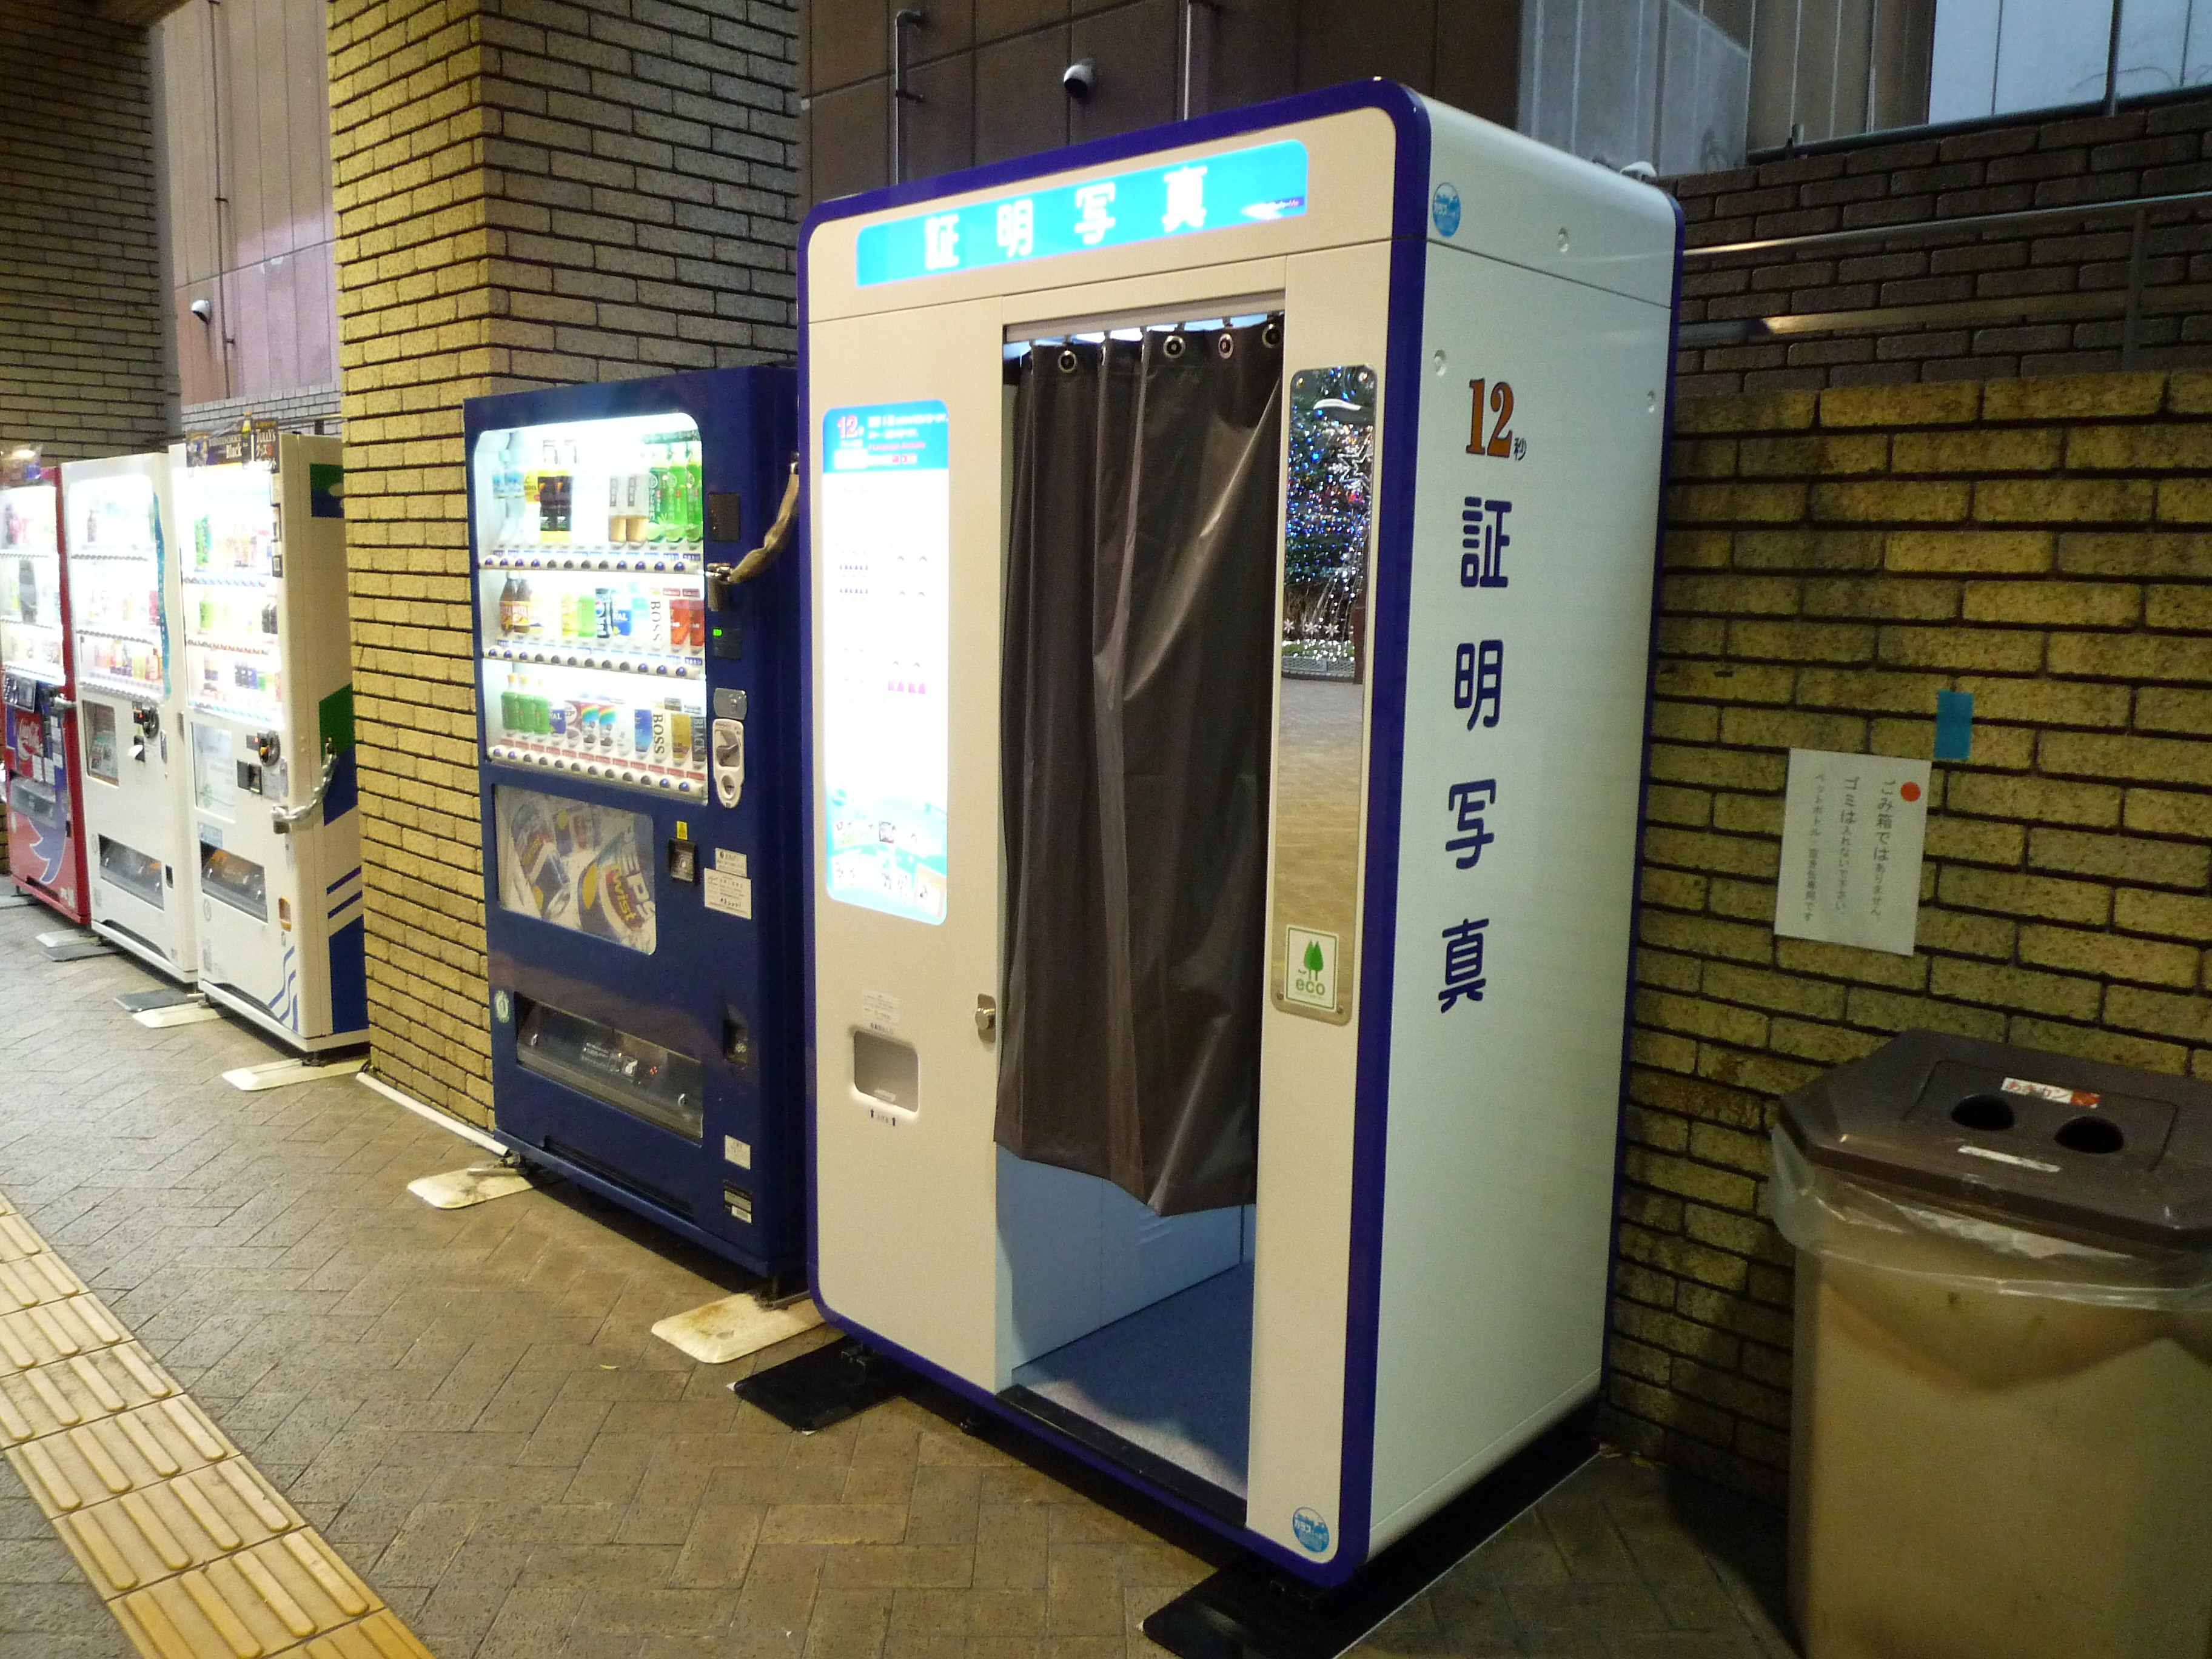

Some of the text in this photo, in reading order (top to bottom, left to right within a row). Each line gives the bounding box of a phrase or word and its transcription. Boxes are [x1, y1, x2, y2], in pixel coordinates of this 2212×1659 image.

[923, 165, 1209, 271] 証明写真
[1466, 378, 1527, 461] 12秒
[651, 601, 663, 642] BOSS
[653, 714, 665, 754] BOSS
[693, 717, 706, 753] BLACK
[1438, 496, 1512, 1013] 証明写真
[1296, 978, 1325, 995] eco
